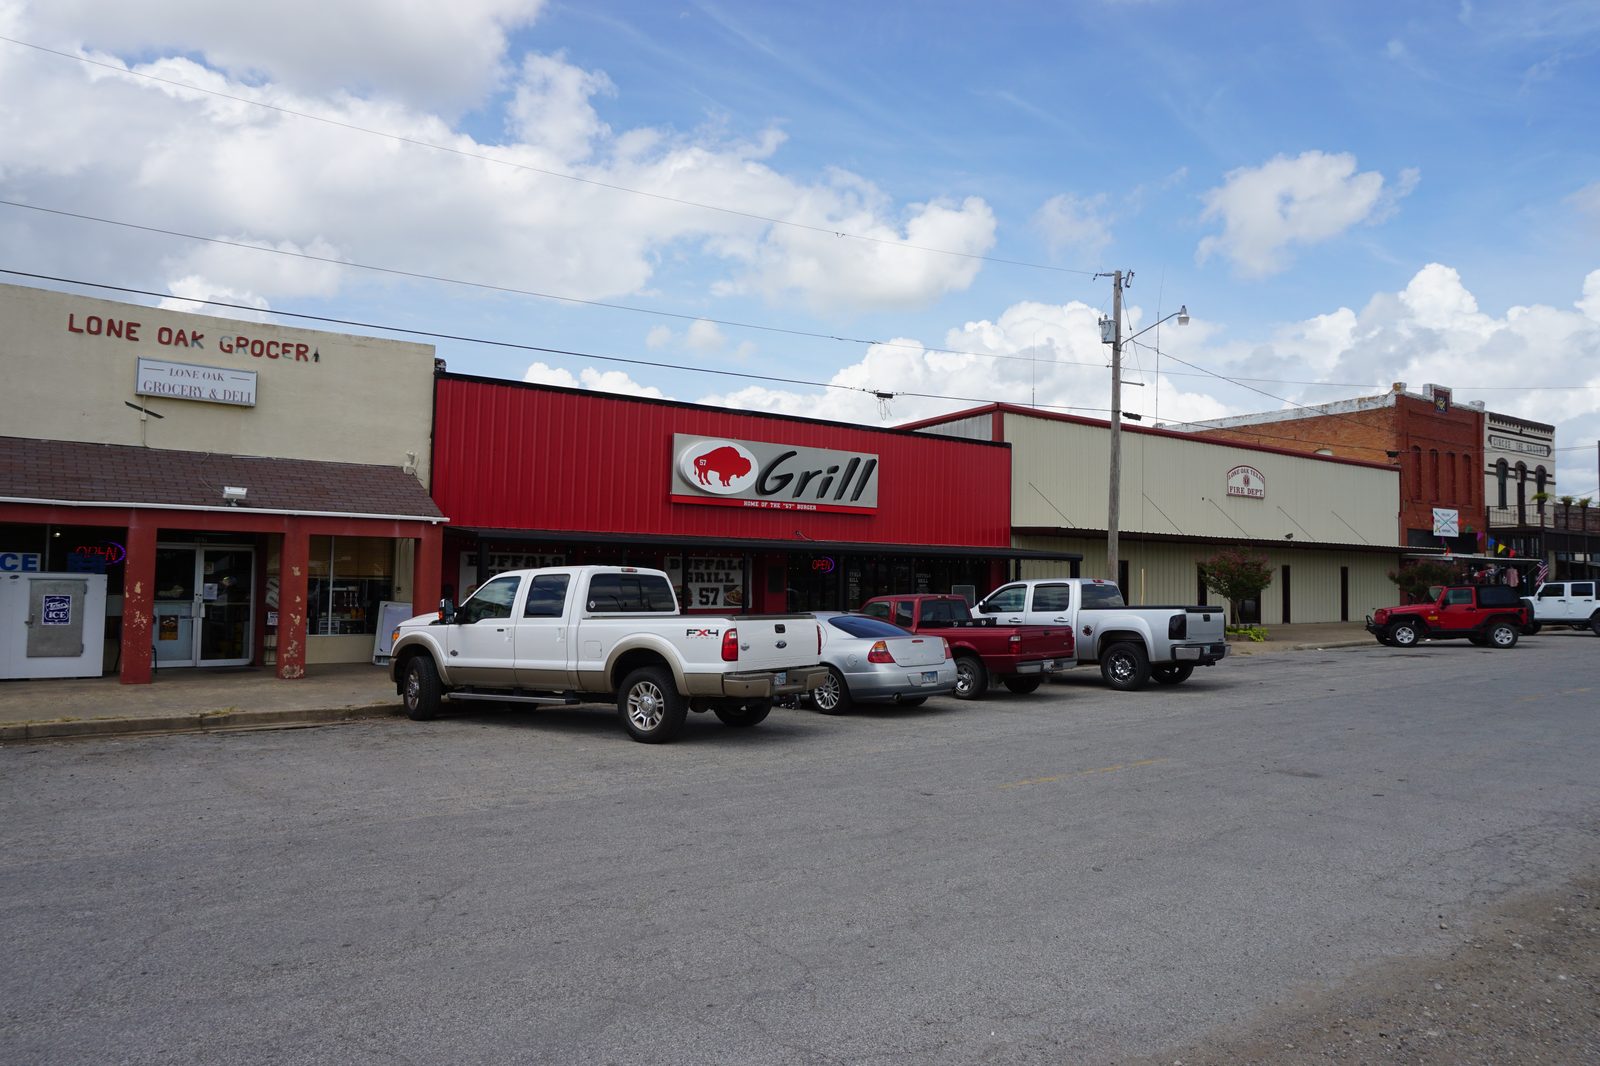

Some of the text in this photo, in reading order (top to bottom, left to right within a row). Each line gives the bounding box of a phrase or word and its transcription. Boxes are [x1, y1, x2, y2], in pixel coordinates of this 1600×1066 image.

[68, 313, 141, 342] LONE
[157, 327, 205, 349] OAK
[169, 367, 224, 382] LONE OAK
[143, 380, 252, 403] GROCERY & DELI
[755, 450, 877, 501] Grill
[1229, 486, 1245, 494] FIRE
[812, 559, 831, 570] OPEN
[698, 587, 720, 606] 57
